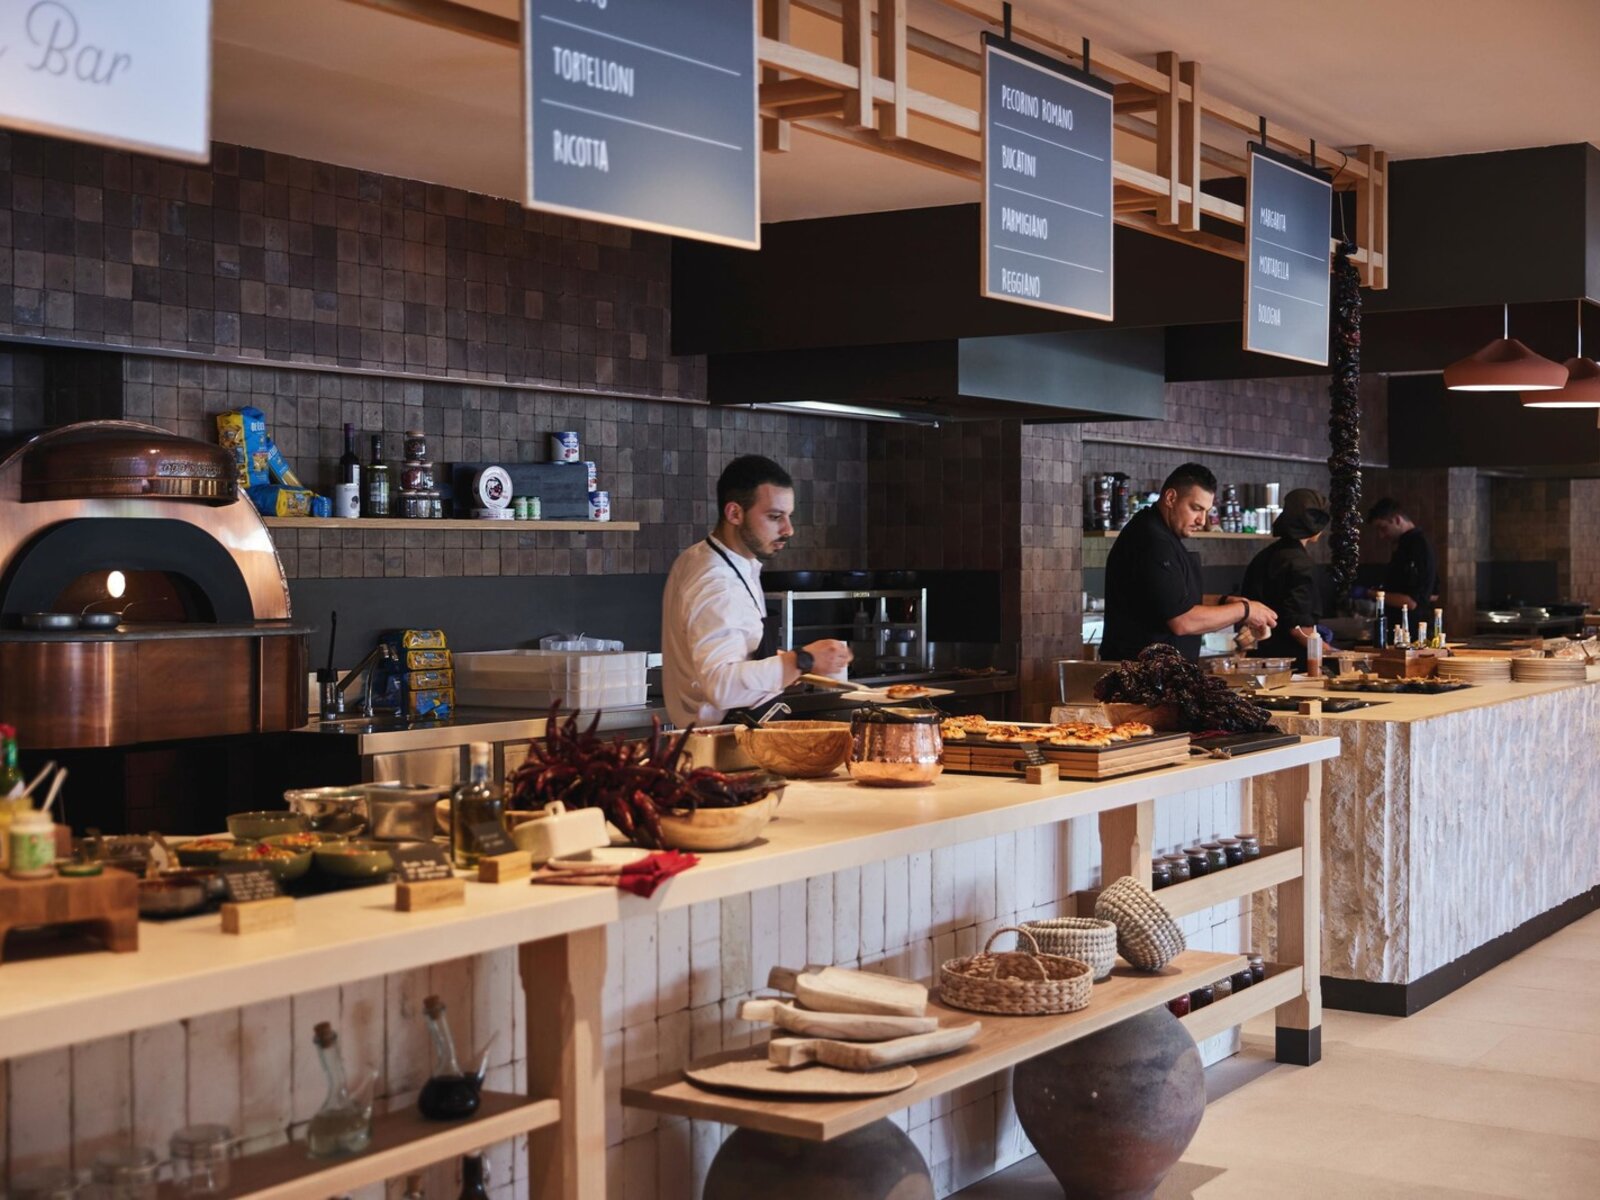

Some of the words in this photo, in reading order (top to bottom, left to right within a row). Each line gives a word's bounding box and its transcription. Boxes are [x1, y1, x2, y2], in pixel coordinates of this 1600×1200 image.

[26, 0, 132, 85] Bar
[553, 46, 634, 97] TORTELLONI
[1002, 84, 1039, 118] PECORINO
[1042, 98, 1074, 131] ROMANO
[553, 129, 609, 172] RICOTTA
[1002, 144, 1036, 178] BUCATINI
[1002, 206, 1048, 240] PARMIGIANO
[1260, 207, 1286, 232] MARGARITA
[1002, 267, 1040, 298] REGGIANO
[1258, 255, 1289, 280] MORTADELLA
[1258, 303, 1281, 326] BOLOGNA
